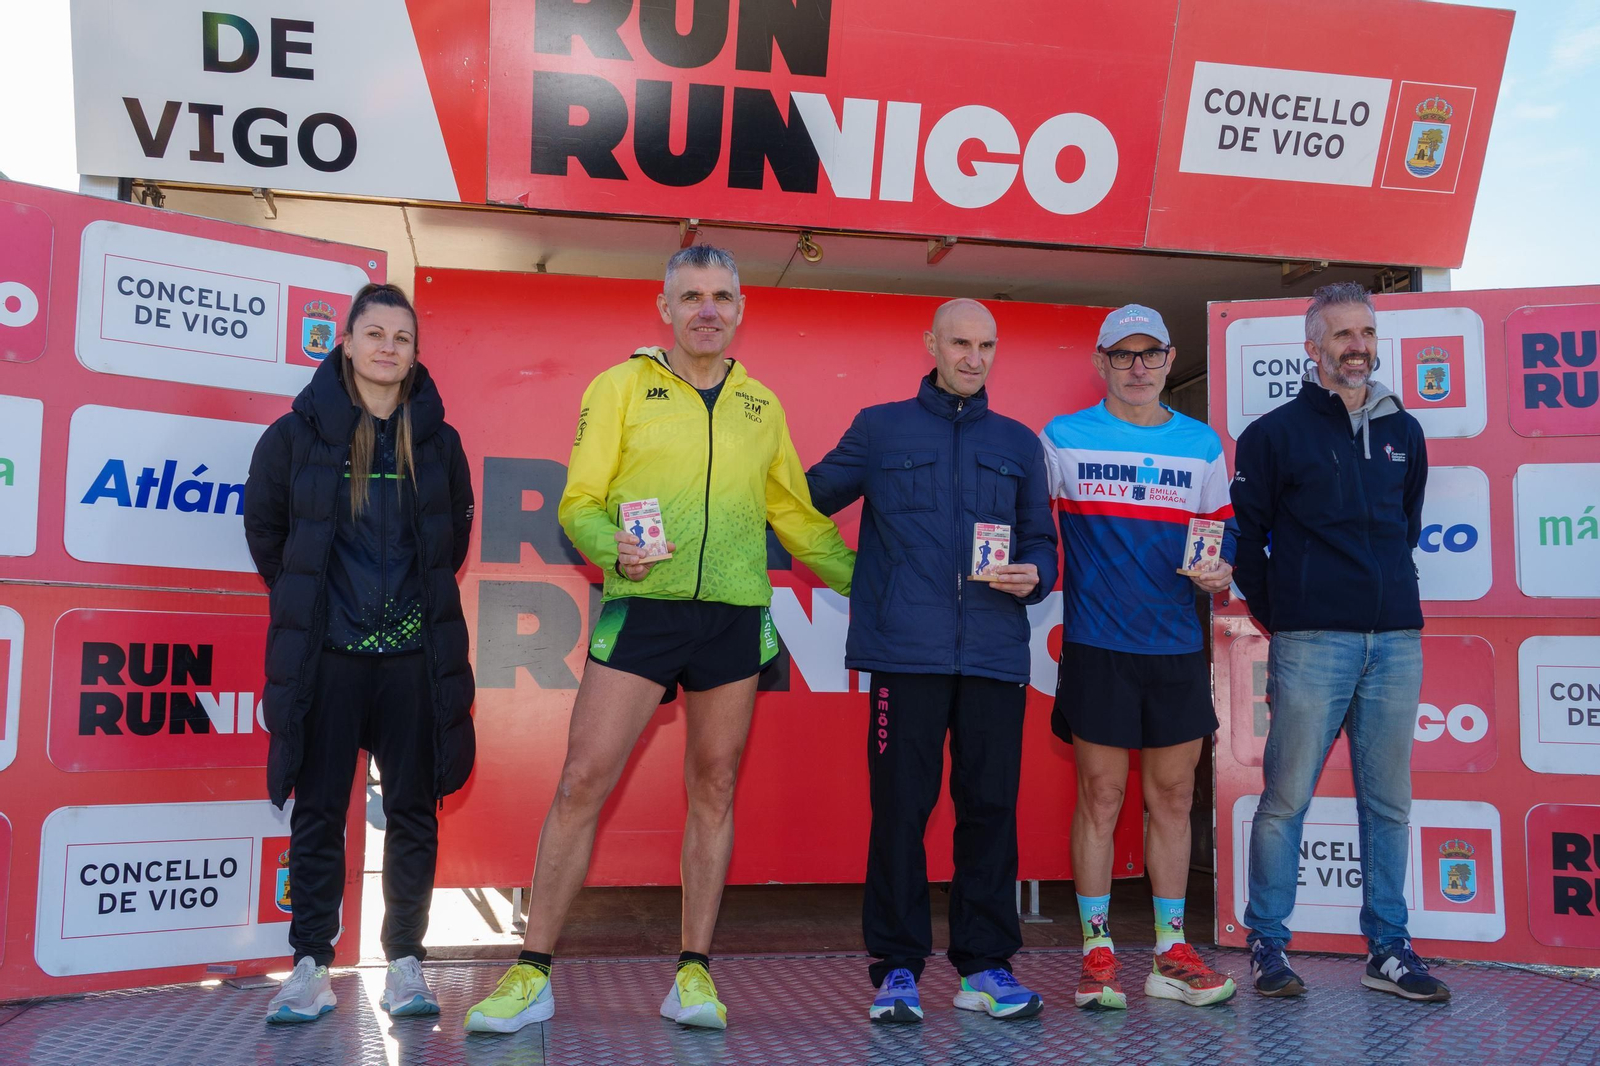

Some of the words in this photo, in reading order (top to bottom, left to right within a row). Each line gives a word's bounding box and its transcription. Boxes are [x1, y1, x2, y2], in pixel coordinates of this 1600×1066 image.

[202, 11, 315, 81] DE
[535, 0, 831, 77] RUN
[1204, 88, 1370, 127] CONCELLO
[122, 97, 358, 172] VIGO
[1218, 125, 1260, 153] DE
[1272, 129, 1345, 159] VIGO
[117, 275, 266, 316] CONCELLO
[135, 304, 171, 329] DE
[182, 311, 249, 339] VIGO
[1120, 316, 1150, 325] KELME
[1268, 381, 1298, 398] DE
[744, 411, 762, 424] VIGO
[80, 458, 245, 516] Atlán
[1078, 458, 1192, 489] IRONMAN
[1078, 483, 1128, 497] ITALY
[1150, 488, 1177, 496] EMILIA
[80, 641, 214, 686] RUN
[1413, 703, 1489, 743] GO
[1568, 707, 1600, 726] DE
[1300, 841, 1360, 862] NCEL
[79, 857, 238, 886] CONCELLO
[1316, 868, 1363, 888] VIG
[98, 892, 137, 915] DE
[149, 886, 219, 911] VIGO
